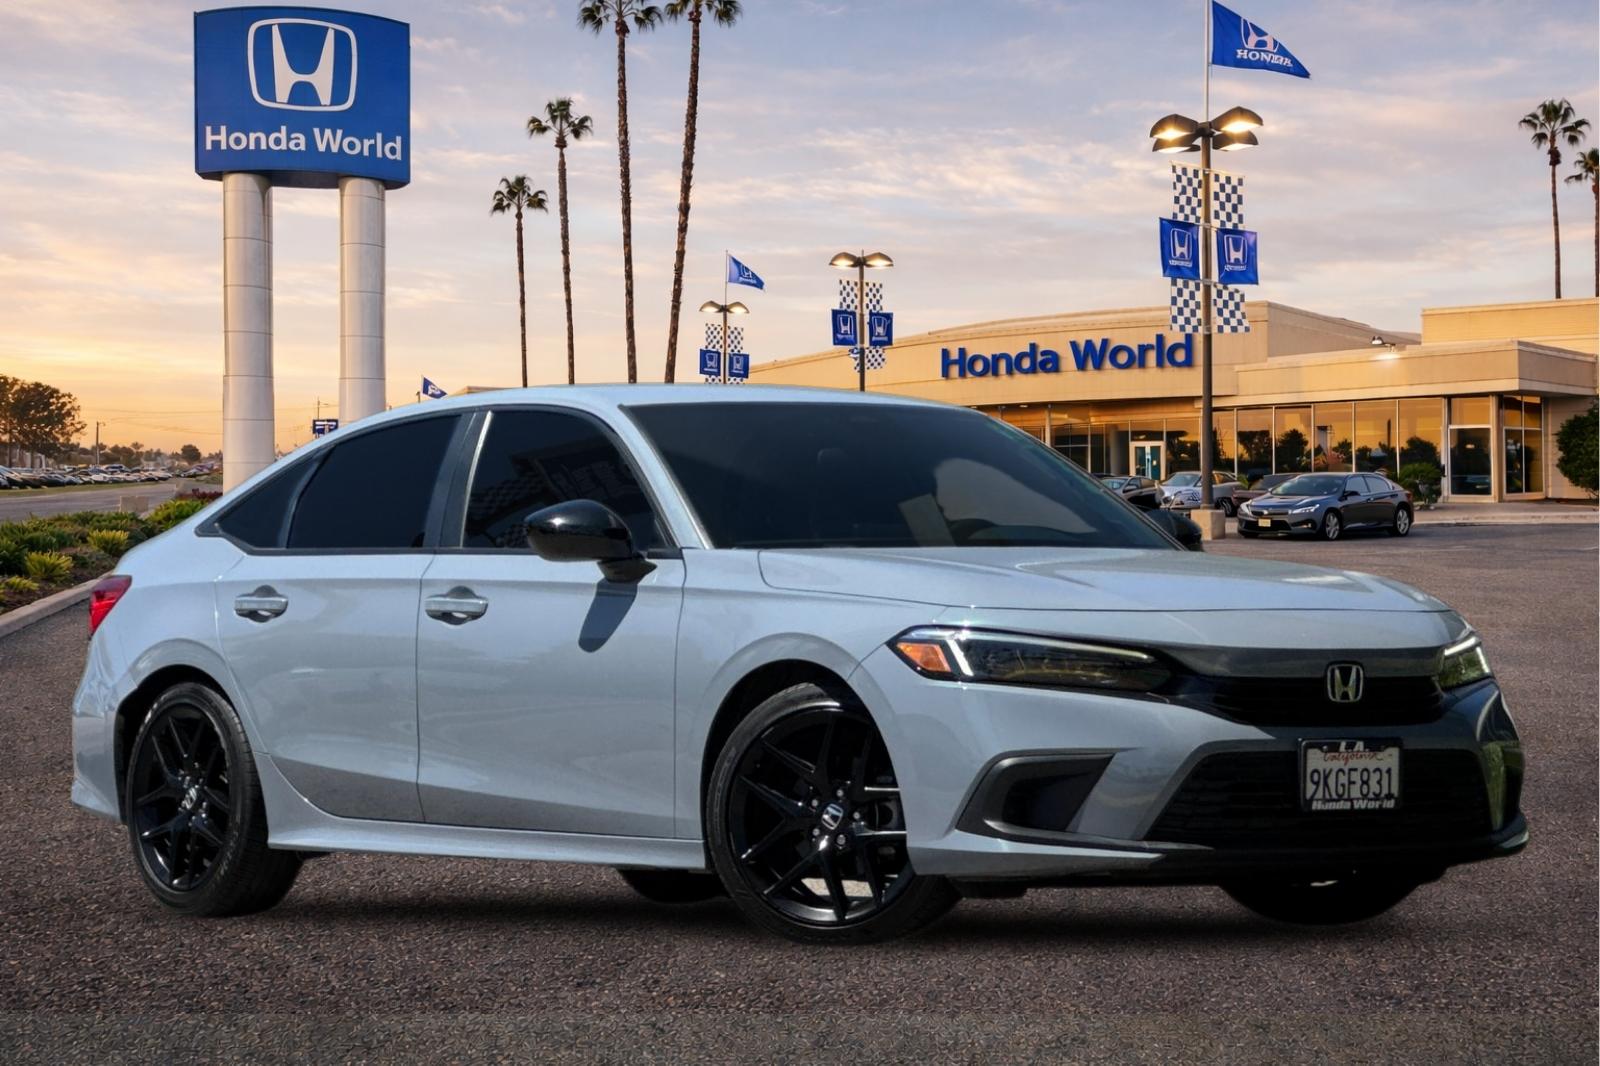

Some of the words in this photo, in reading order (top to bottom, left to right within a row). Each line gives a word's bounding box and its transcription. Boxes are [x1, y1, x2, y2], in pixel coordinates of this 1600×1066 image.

[205, 125, 306, 151] Honda
[313, 127, 402, 161] World
[941, 342, 1061, 379] Honda
[1069, 333, 1194, 371] World
[1310, 767, 1394, 800] 9KGF831
[1312, 799, 1352, 810] Honda
[1352, 799, 1396, 809] World
